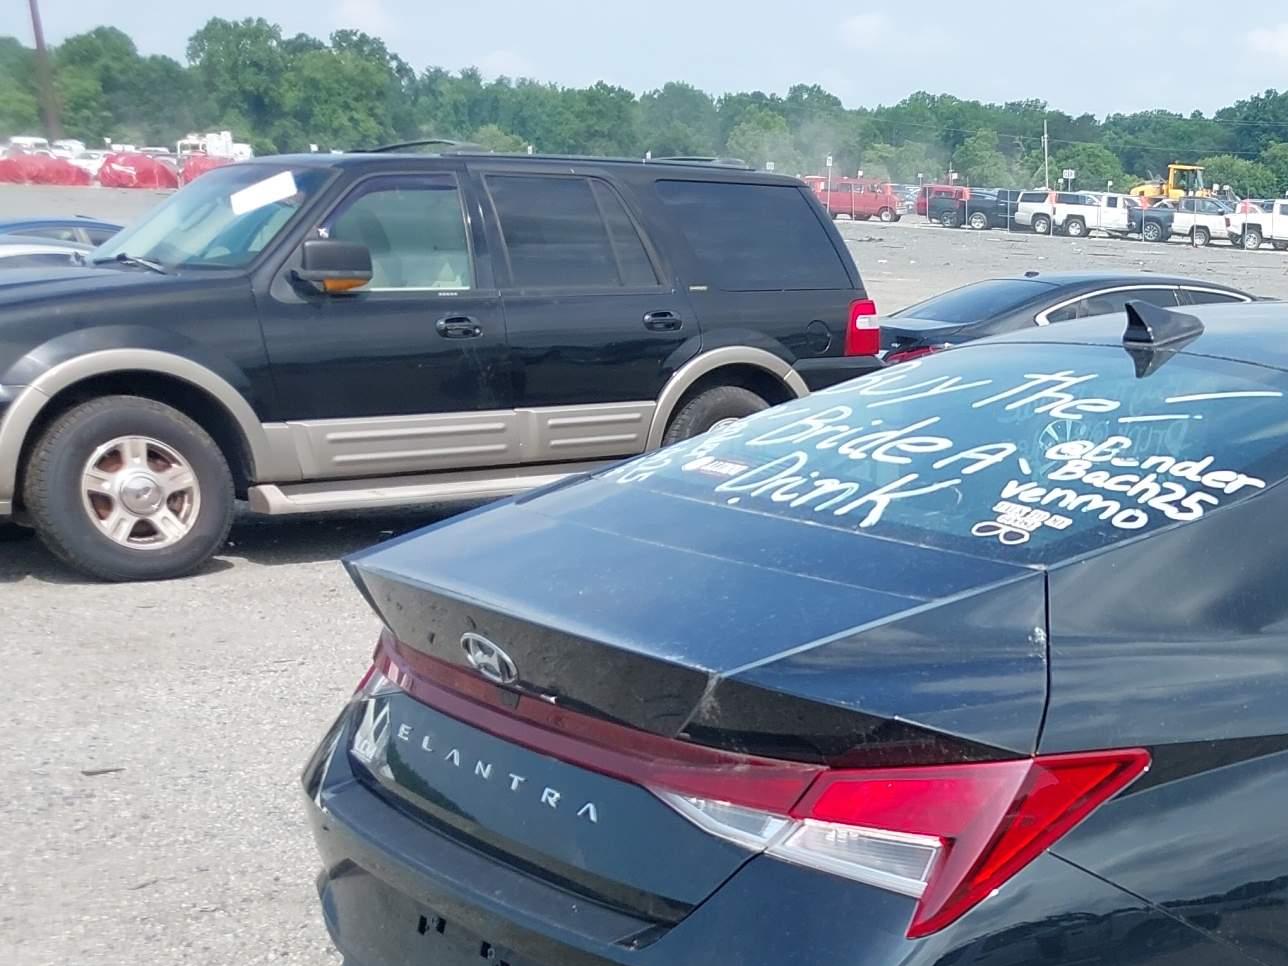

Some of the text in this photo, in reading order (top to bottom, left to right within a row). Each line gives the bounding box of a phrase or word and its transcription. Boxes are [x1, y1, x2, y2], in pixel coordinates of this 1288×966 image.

[746, 406, 953, 465] Bride
[1047, 459, 1219, 521] Bach25
[396, 724, 599, 824] ELANTRA
